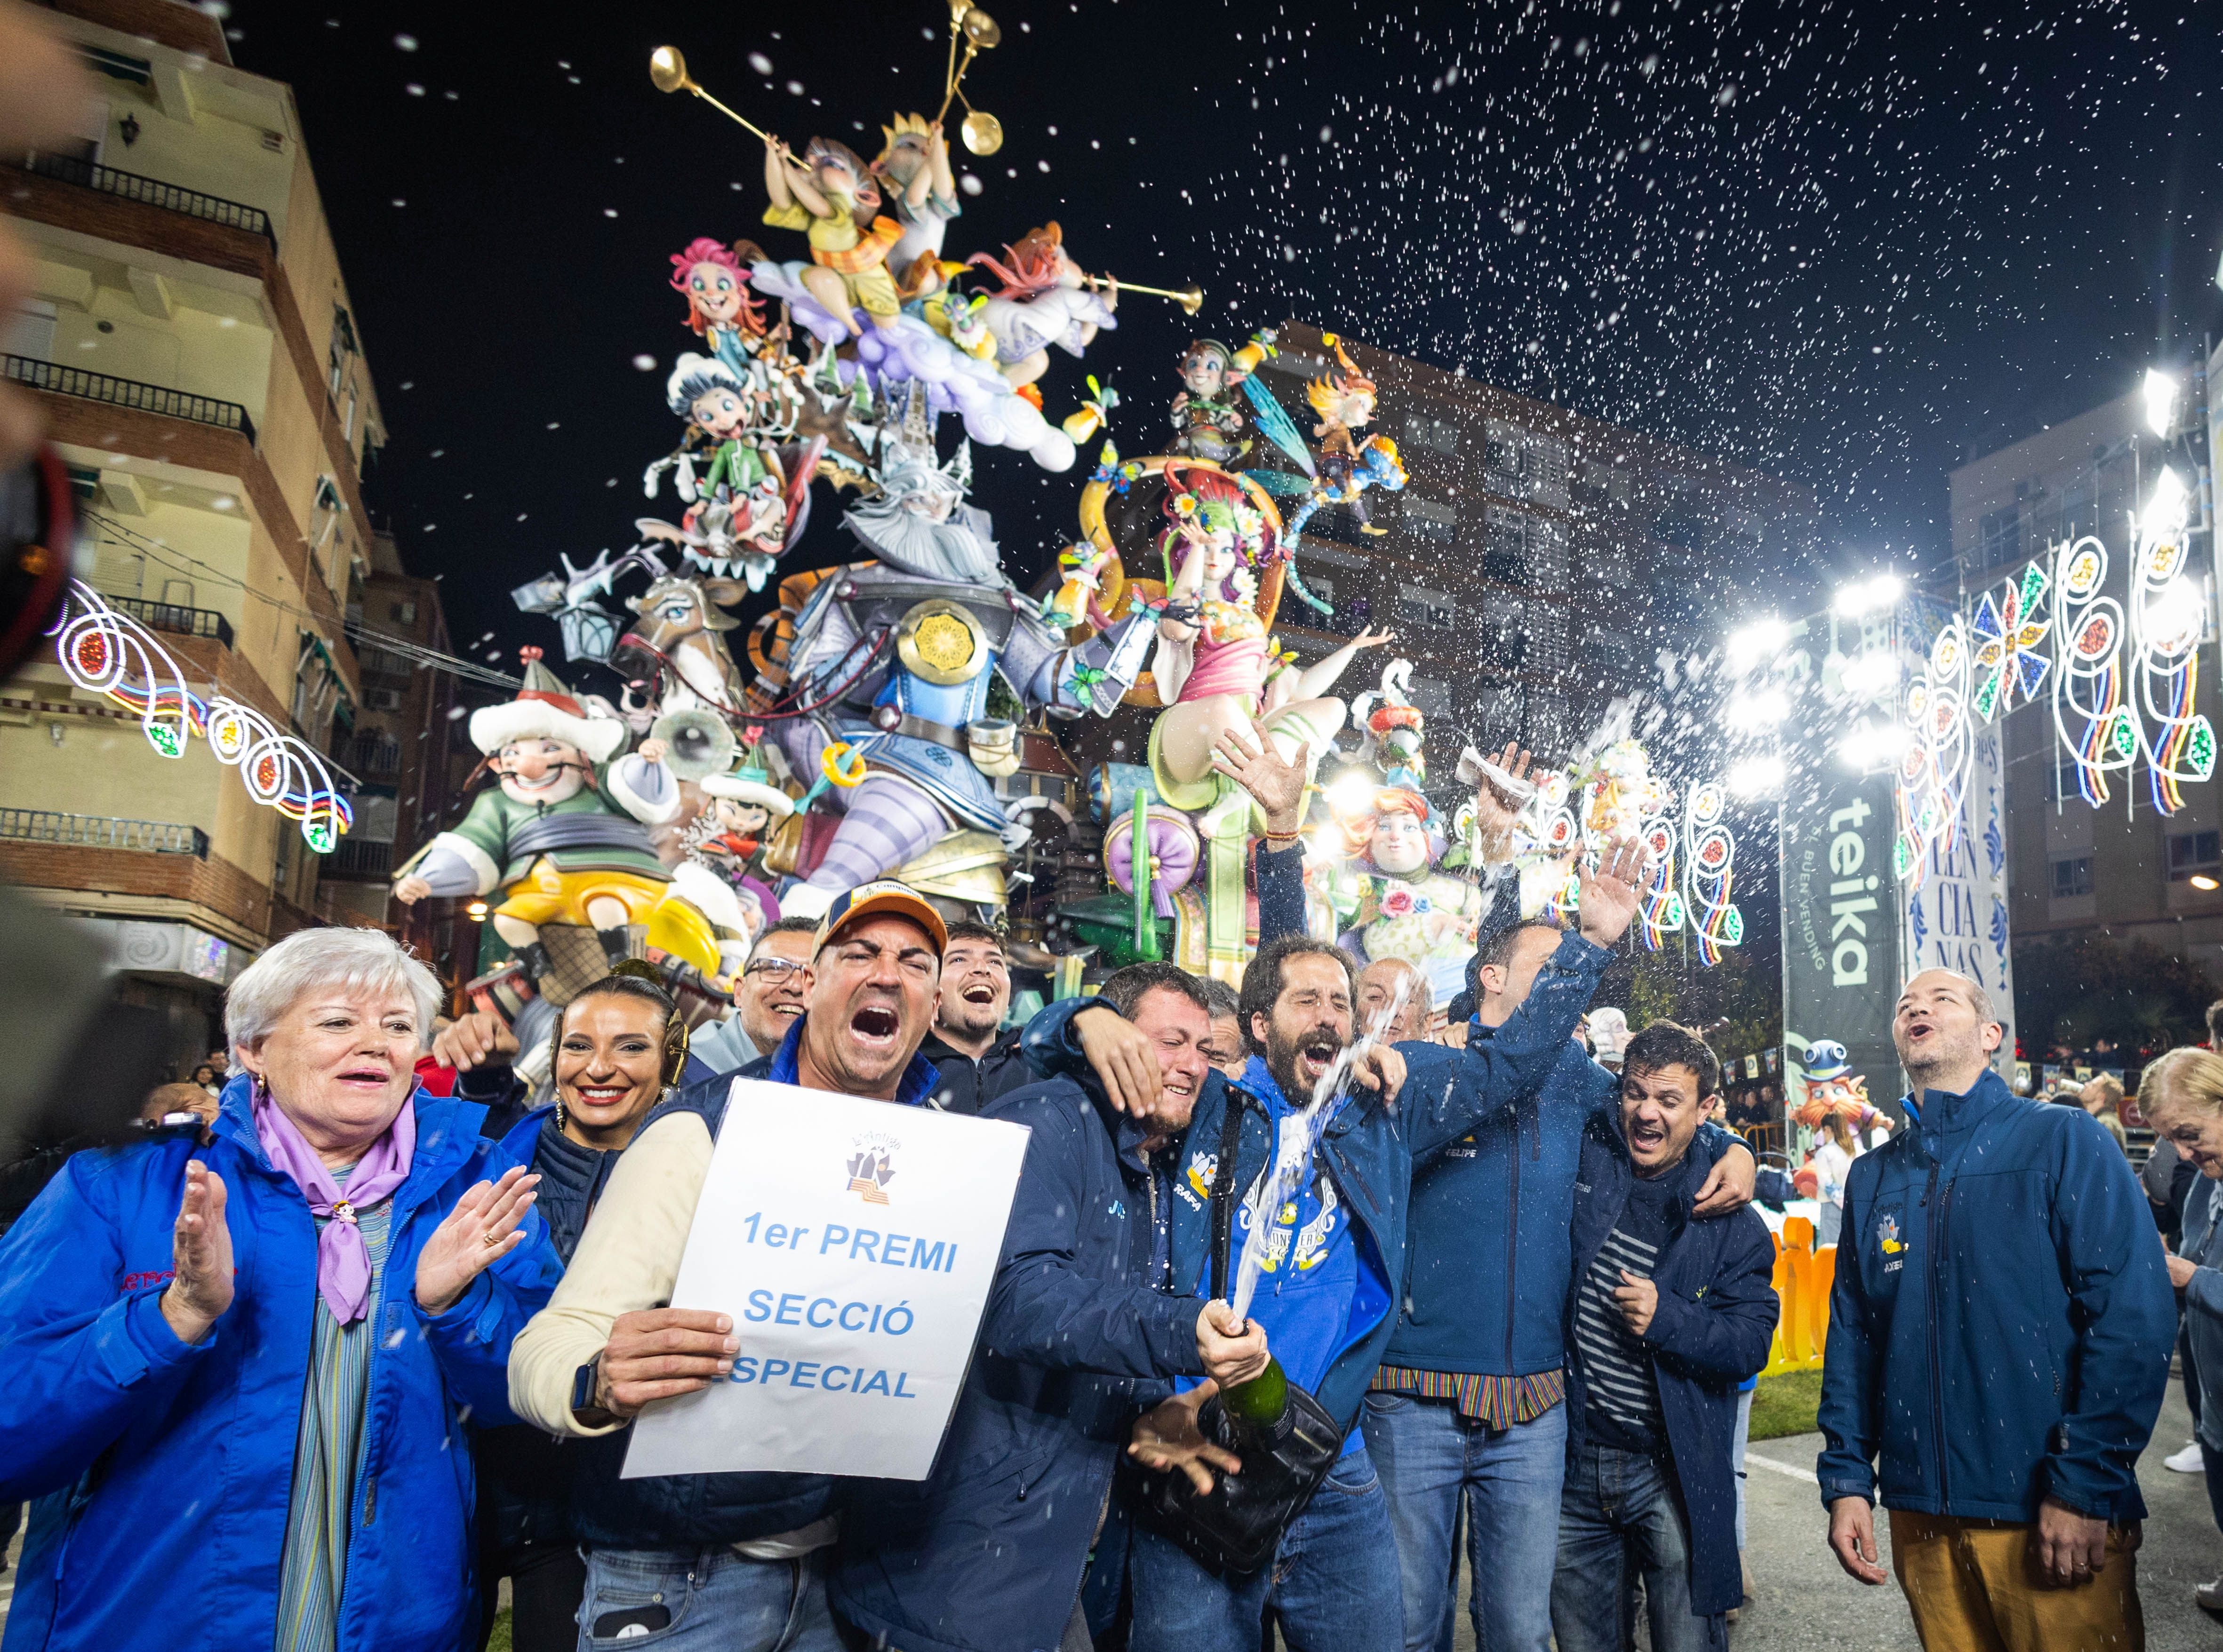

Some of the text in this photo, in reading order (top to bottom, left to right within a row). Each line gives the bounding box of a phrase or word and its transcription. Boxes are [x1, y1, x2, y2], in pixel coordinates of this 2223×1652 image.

[1799, 850, 1815, 894] BUEN
[1829, 797, 1878, 986] teika
[1939, 881, 1977, 937] CIA
[1799, 899, 1826, 971] VENDING
[1174, 1183, 1202, 1212] RAFA
[744, 1212, 958, 1273] 1er PREMI
[744, 1289, 914, 1335] SECCIÓ
[712, 1356, 917, 1398] SPECIAL
